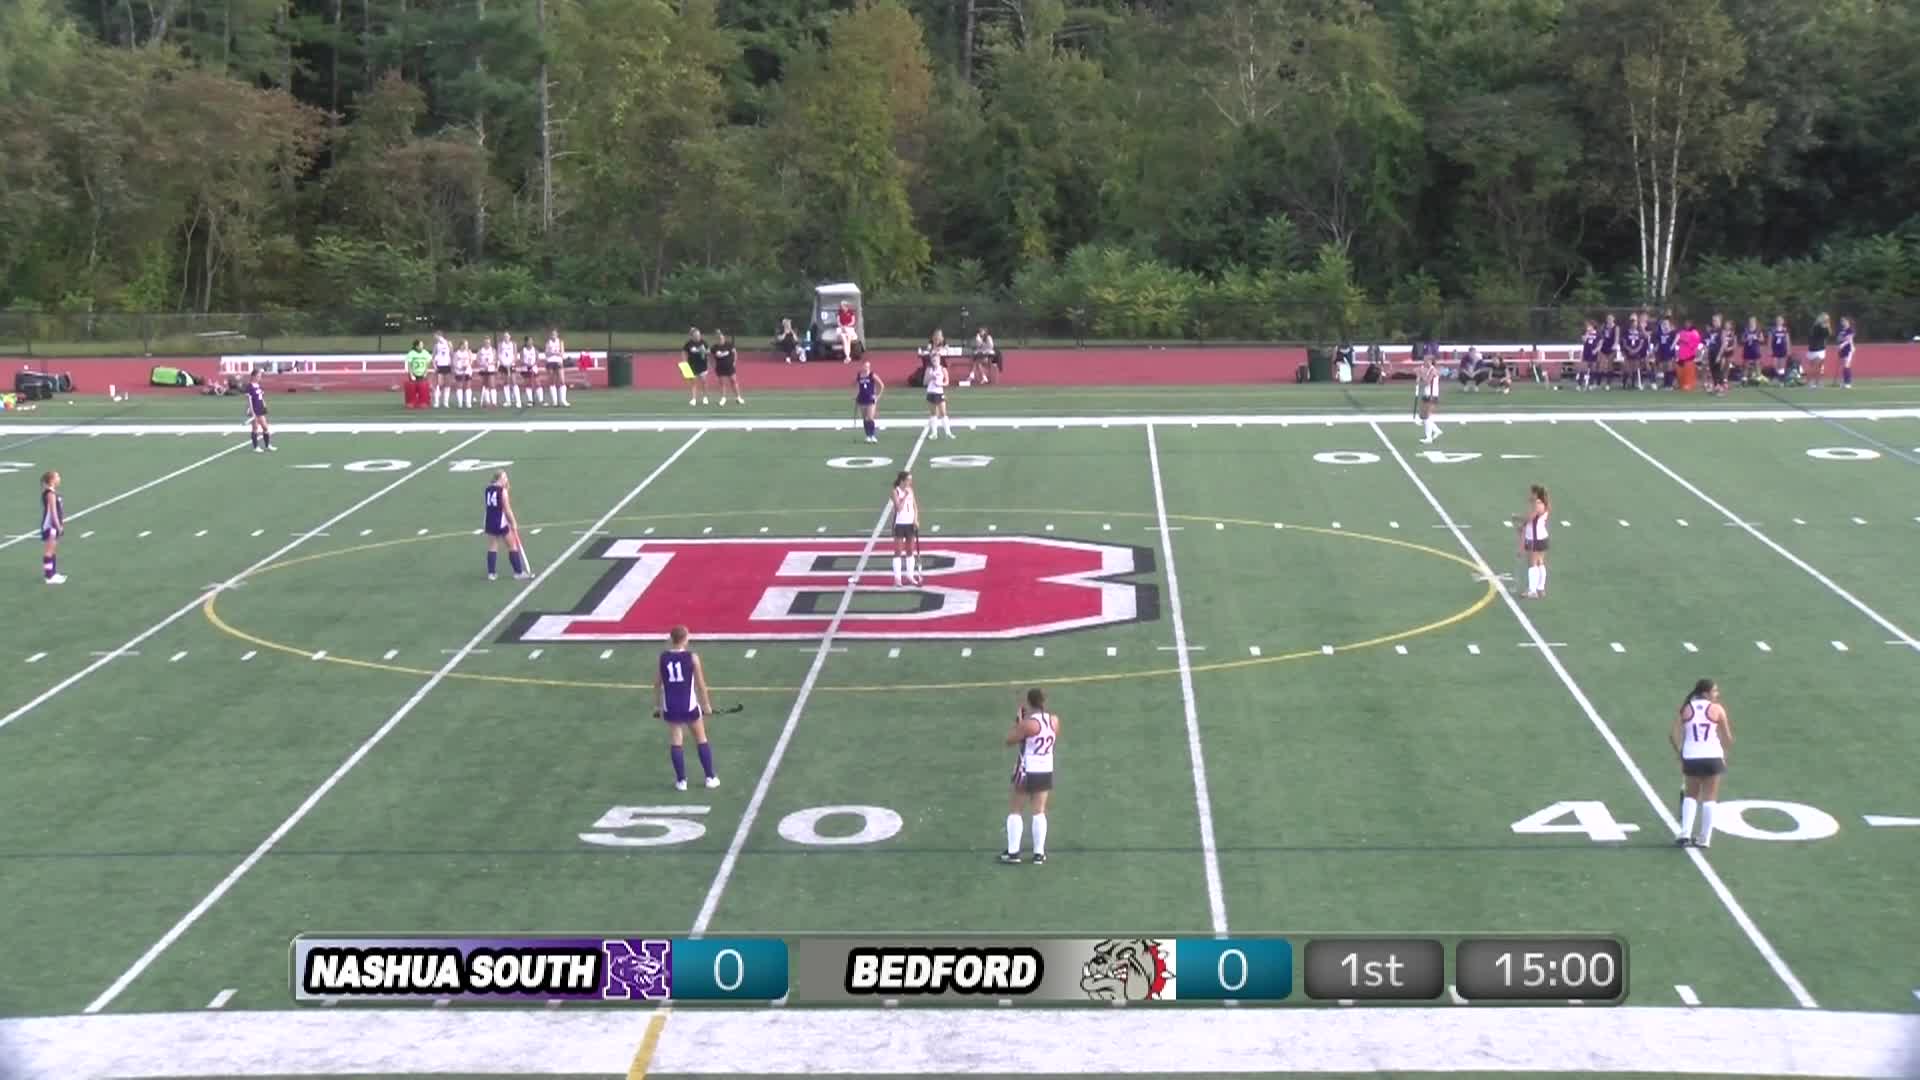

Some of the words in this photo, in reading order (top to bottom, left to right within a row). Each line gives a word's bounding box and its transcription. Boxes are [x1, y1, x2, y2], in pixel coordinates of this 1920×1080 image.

[487, 491, 498, 507] 14
[667, 661, 685, 682] 11
[1692, 723, 1711, 742] 17
[1034, 735, 1054, 757] 22
